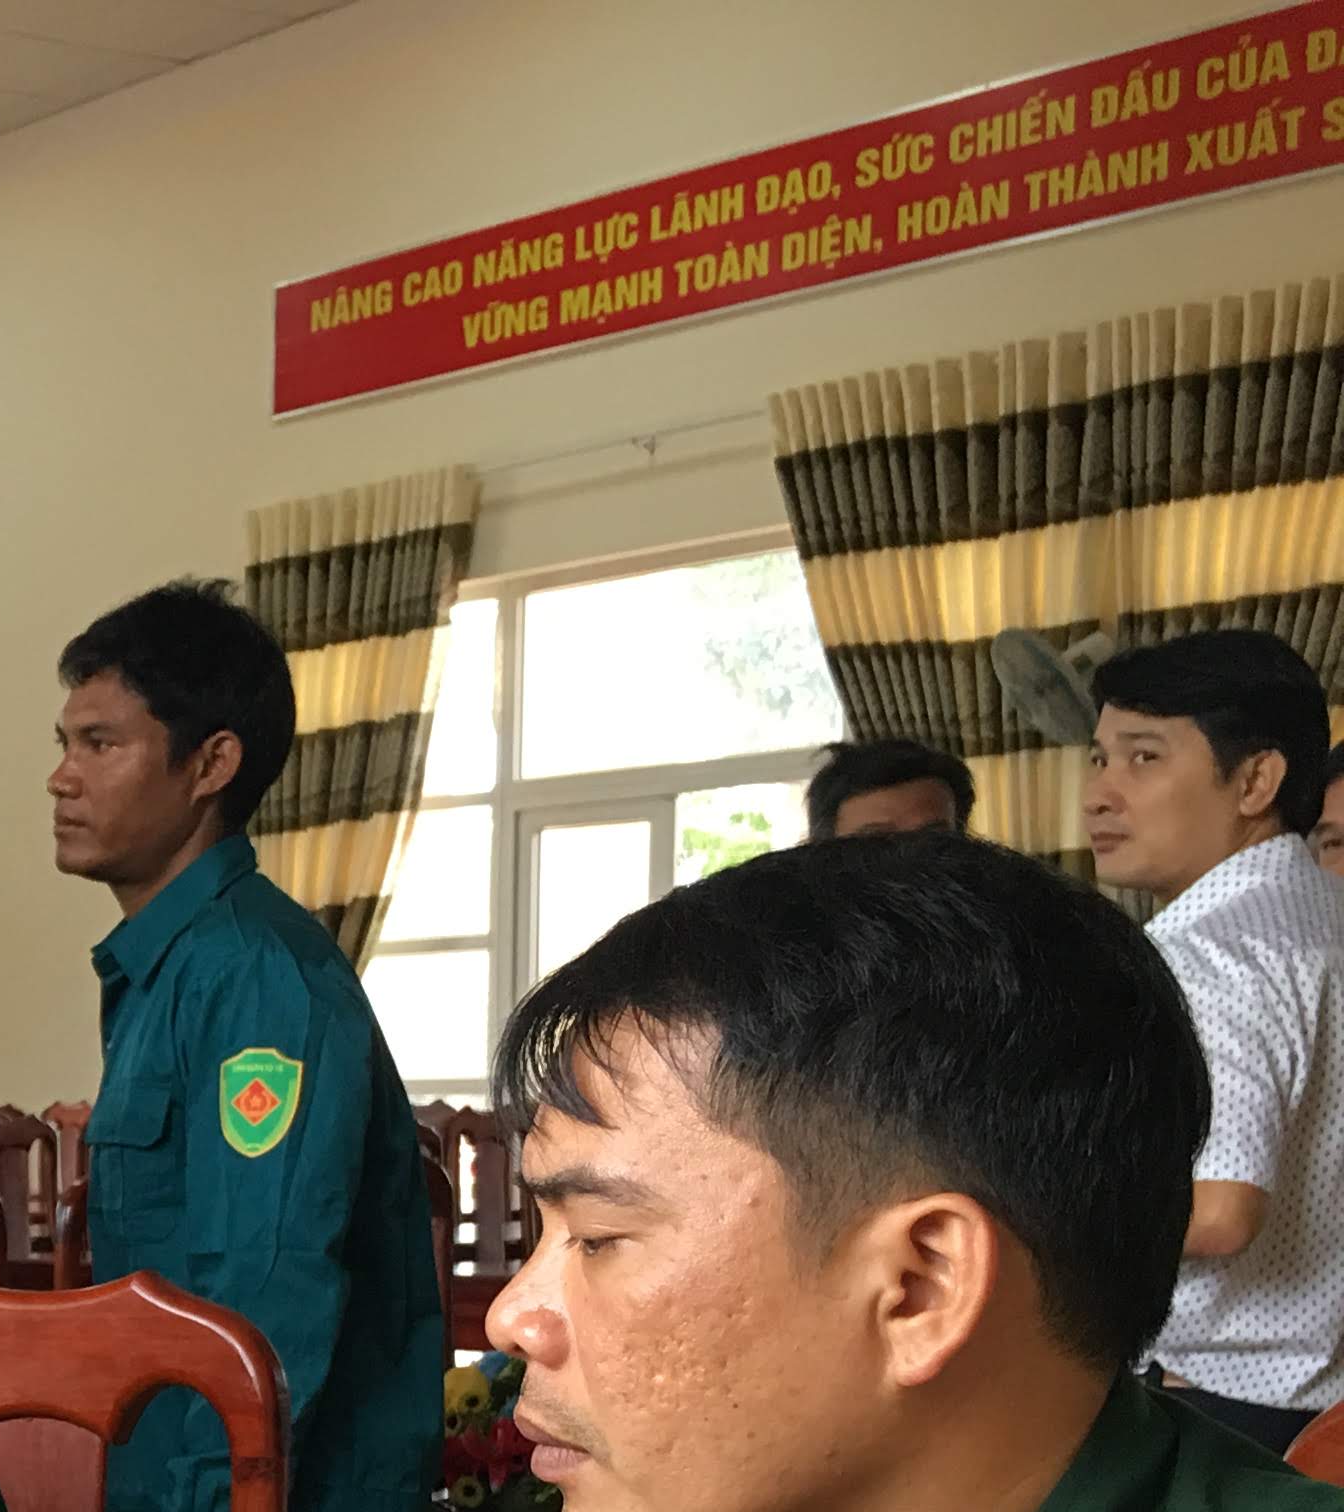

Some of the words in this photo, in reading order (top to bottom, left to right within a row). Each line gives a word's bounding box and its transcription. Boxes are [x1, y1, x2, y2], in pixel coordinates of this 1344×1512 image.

[311, 286, 393, 333] NÂNG
[402, 260, 463, 306] CAO
[472, 239, 564, 288] NĂNG
[575, 212, 639, 262] LỰC
[650, 191, 745, 241] LÃNH
[755, 161, 841, 215] ĐẠO,
[855, 132, 935, 188] SỨC
[948, 88, 1076, 163] CHIẾN
[1090, 59, 1181, 127] ĐẤU
[1196, 34, 1290, 100] CỦA
[1305, 28, 1344, 73] Đ
[463, 297, 549, 349] VỮNG
[559, 267, 663, 324] MẠNH
[674, 241, 769, 296] TOÀN
[781, 214, 883, 272] DIỆN,
[897, 180, 1010, 244] HOÀN
[1024, 141, 1169, 212] THÀNH
[1185, 99, 1306, 174] XUẤT
